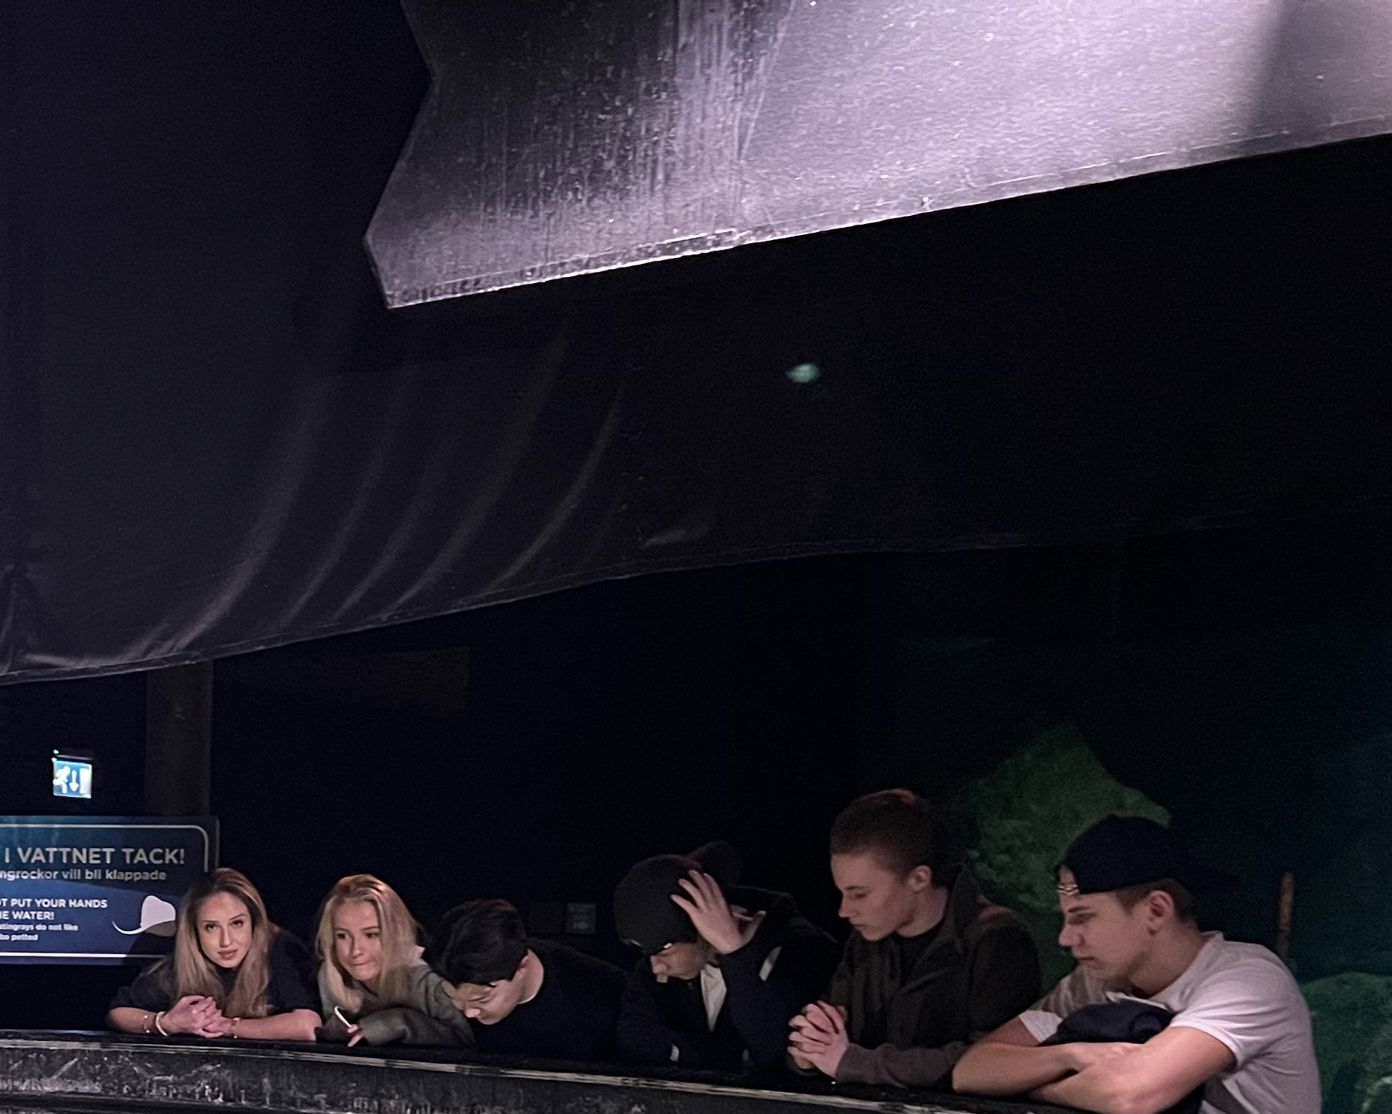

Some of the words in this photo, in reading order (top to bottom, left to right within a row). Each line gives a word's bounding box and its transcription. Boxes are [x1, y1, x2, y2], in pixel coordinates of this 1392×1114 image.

[5, 847, 10, 863] I
[17, 847, 116, 864] VATTNET
[121, 848, 185, 865] TACK!
[62, 869, 81, 880] vill
[85, 869, 102, 880] bli
[105, 869, 167, 882] klappade
[10, 898, 32, 908] PUT
[35, 898, 66, 908] YOUR
[68, 899, 108, 909] HANDS
[12, 911, 55, 920] WATER!
[35, 923, 47, 931] do
[48, 923, 62, 931] not
